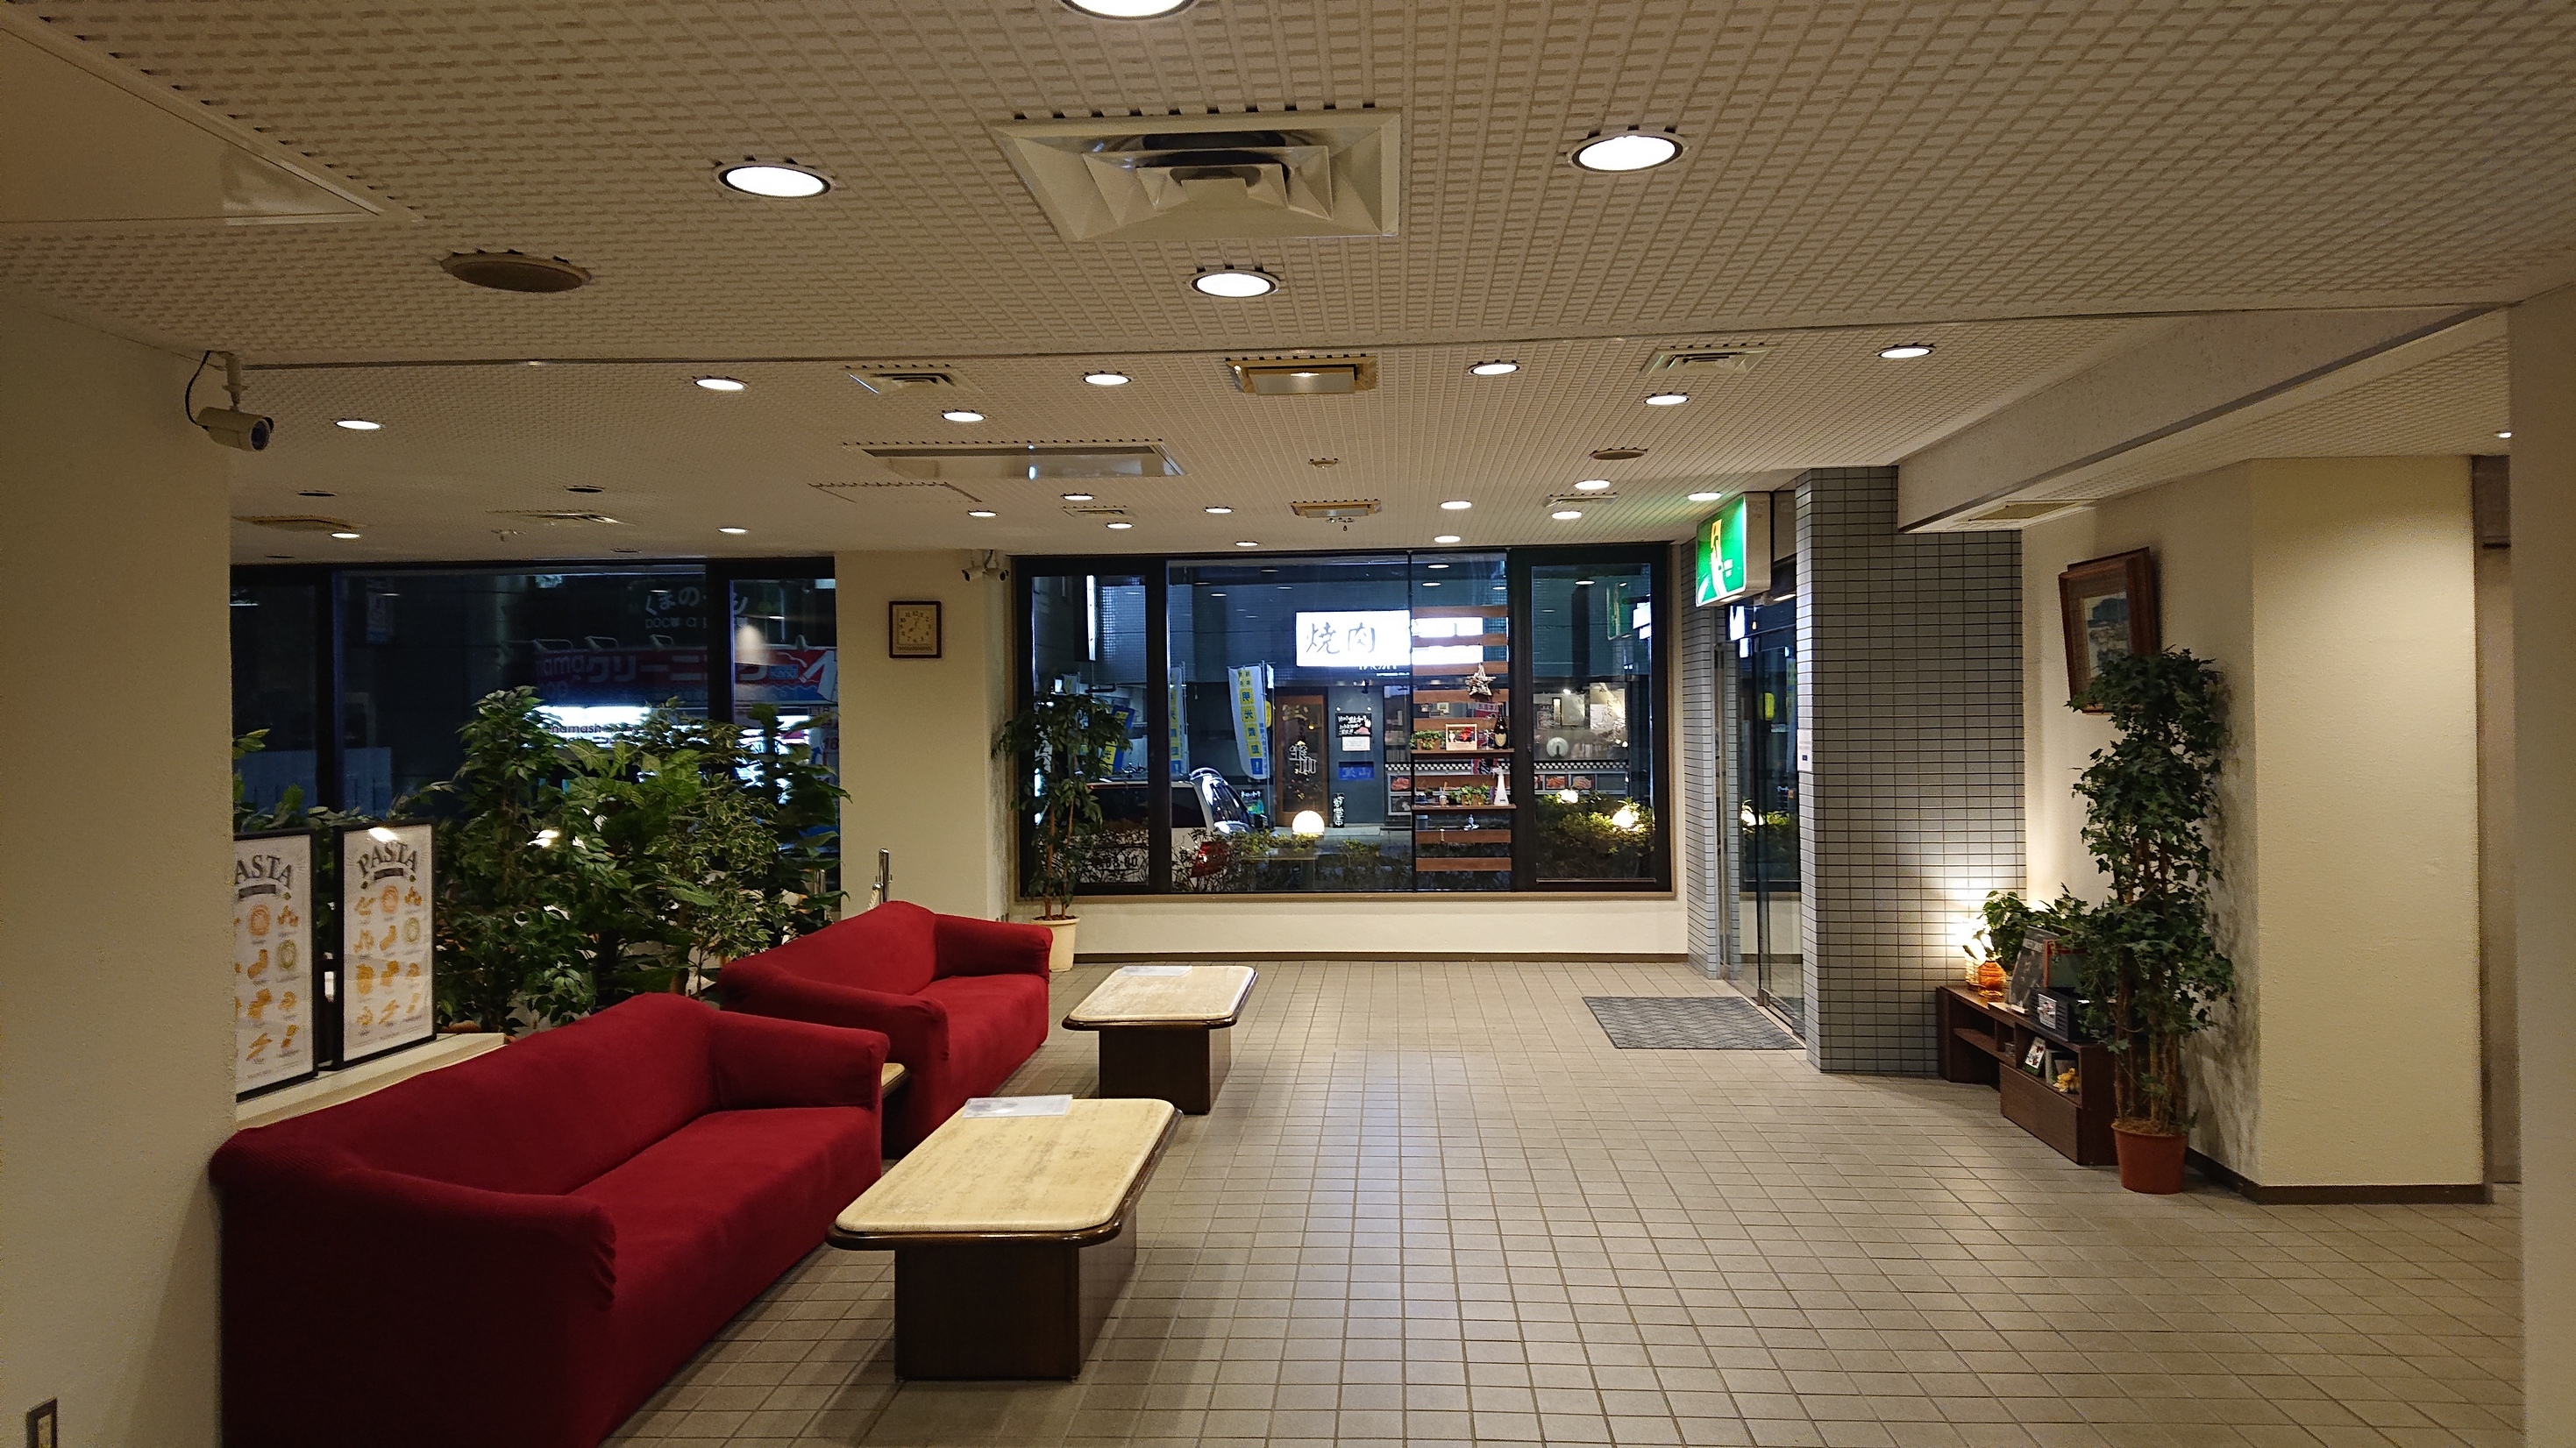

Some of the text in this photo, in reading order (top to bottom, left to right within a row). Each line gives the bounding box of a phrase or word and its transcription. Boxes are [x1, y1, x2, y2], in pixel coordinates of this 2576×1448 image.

[1306, 621, 1377, 654] 焼肉
[234, 854, 293, 890] ASTA
[356, 841, 419, 877] PASTA
